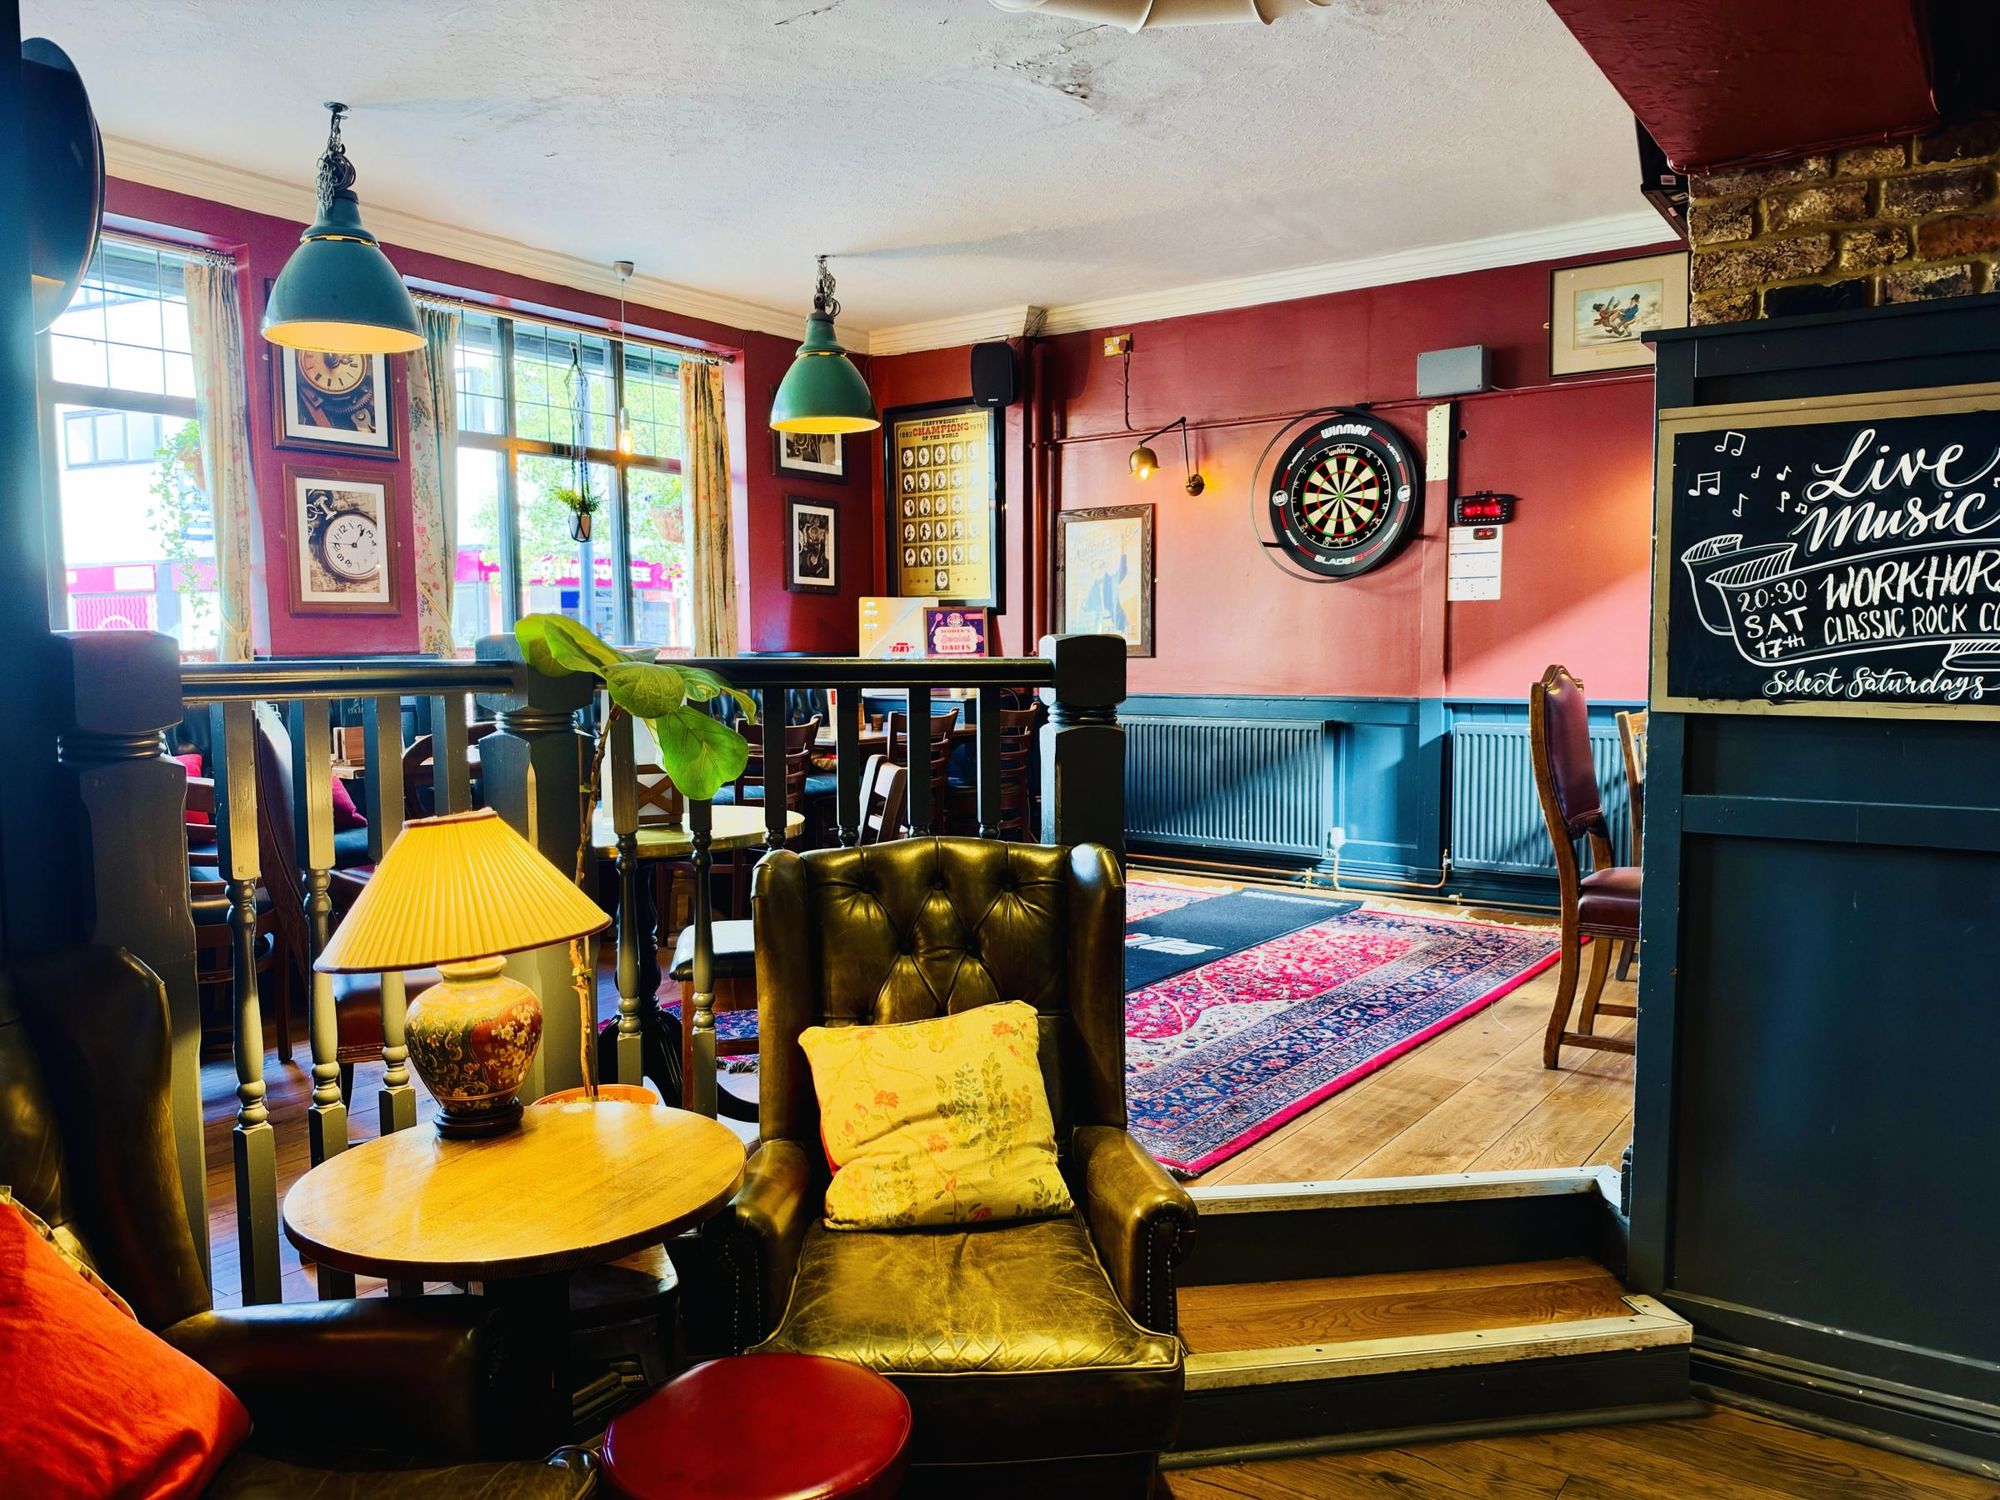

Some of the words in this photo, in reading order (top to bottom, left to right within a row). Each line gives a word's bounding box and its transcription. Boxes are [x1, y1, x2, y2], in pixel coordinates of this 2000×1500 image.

[912, 422, 969, 437] CHAMPIONS
[922, 418, 959, 426] HEAVYWEIGHT
[1321, 424, 1372, 439] WINMAU
[1806, 428, 2000, 502] Live
[1792, 491, 2000, 551] Music
[1314, 554, 1352, 565] BLADE
[1737, 578, 1808, 613] 20:30
[1818, 549, 2000, 611] WORKHOR
[1744, 605, 1808, 639] SAT
[1824, 607, 1906, 646] CLASSIC
[1912, 602, 1967, 636] ROCK
[1755, 634, 1806, 659] 17th
[1764, 668, 1845, 696] Select
[1848, 666, 1986, 700] Saturdays
